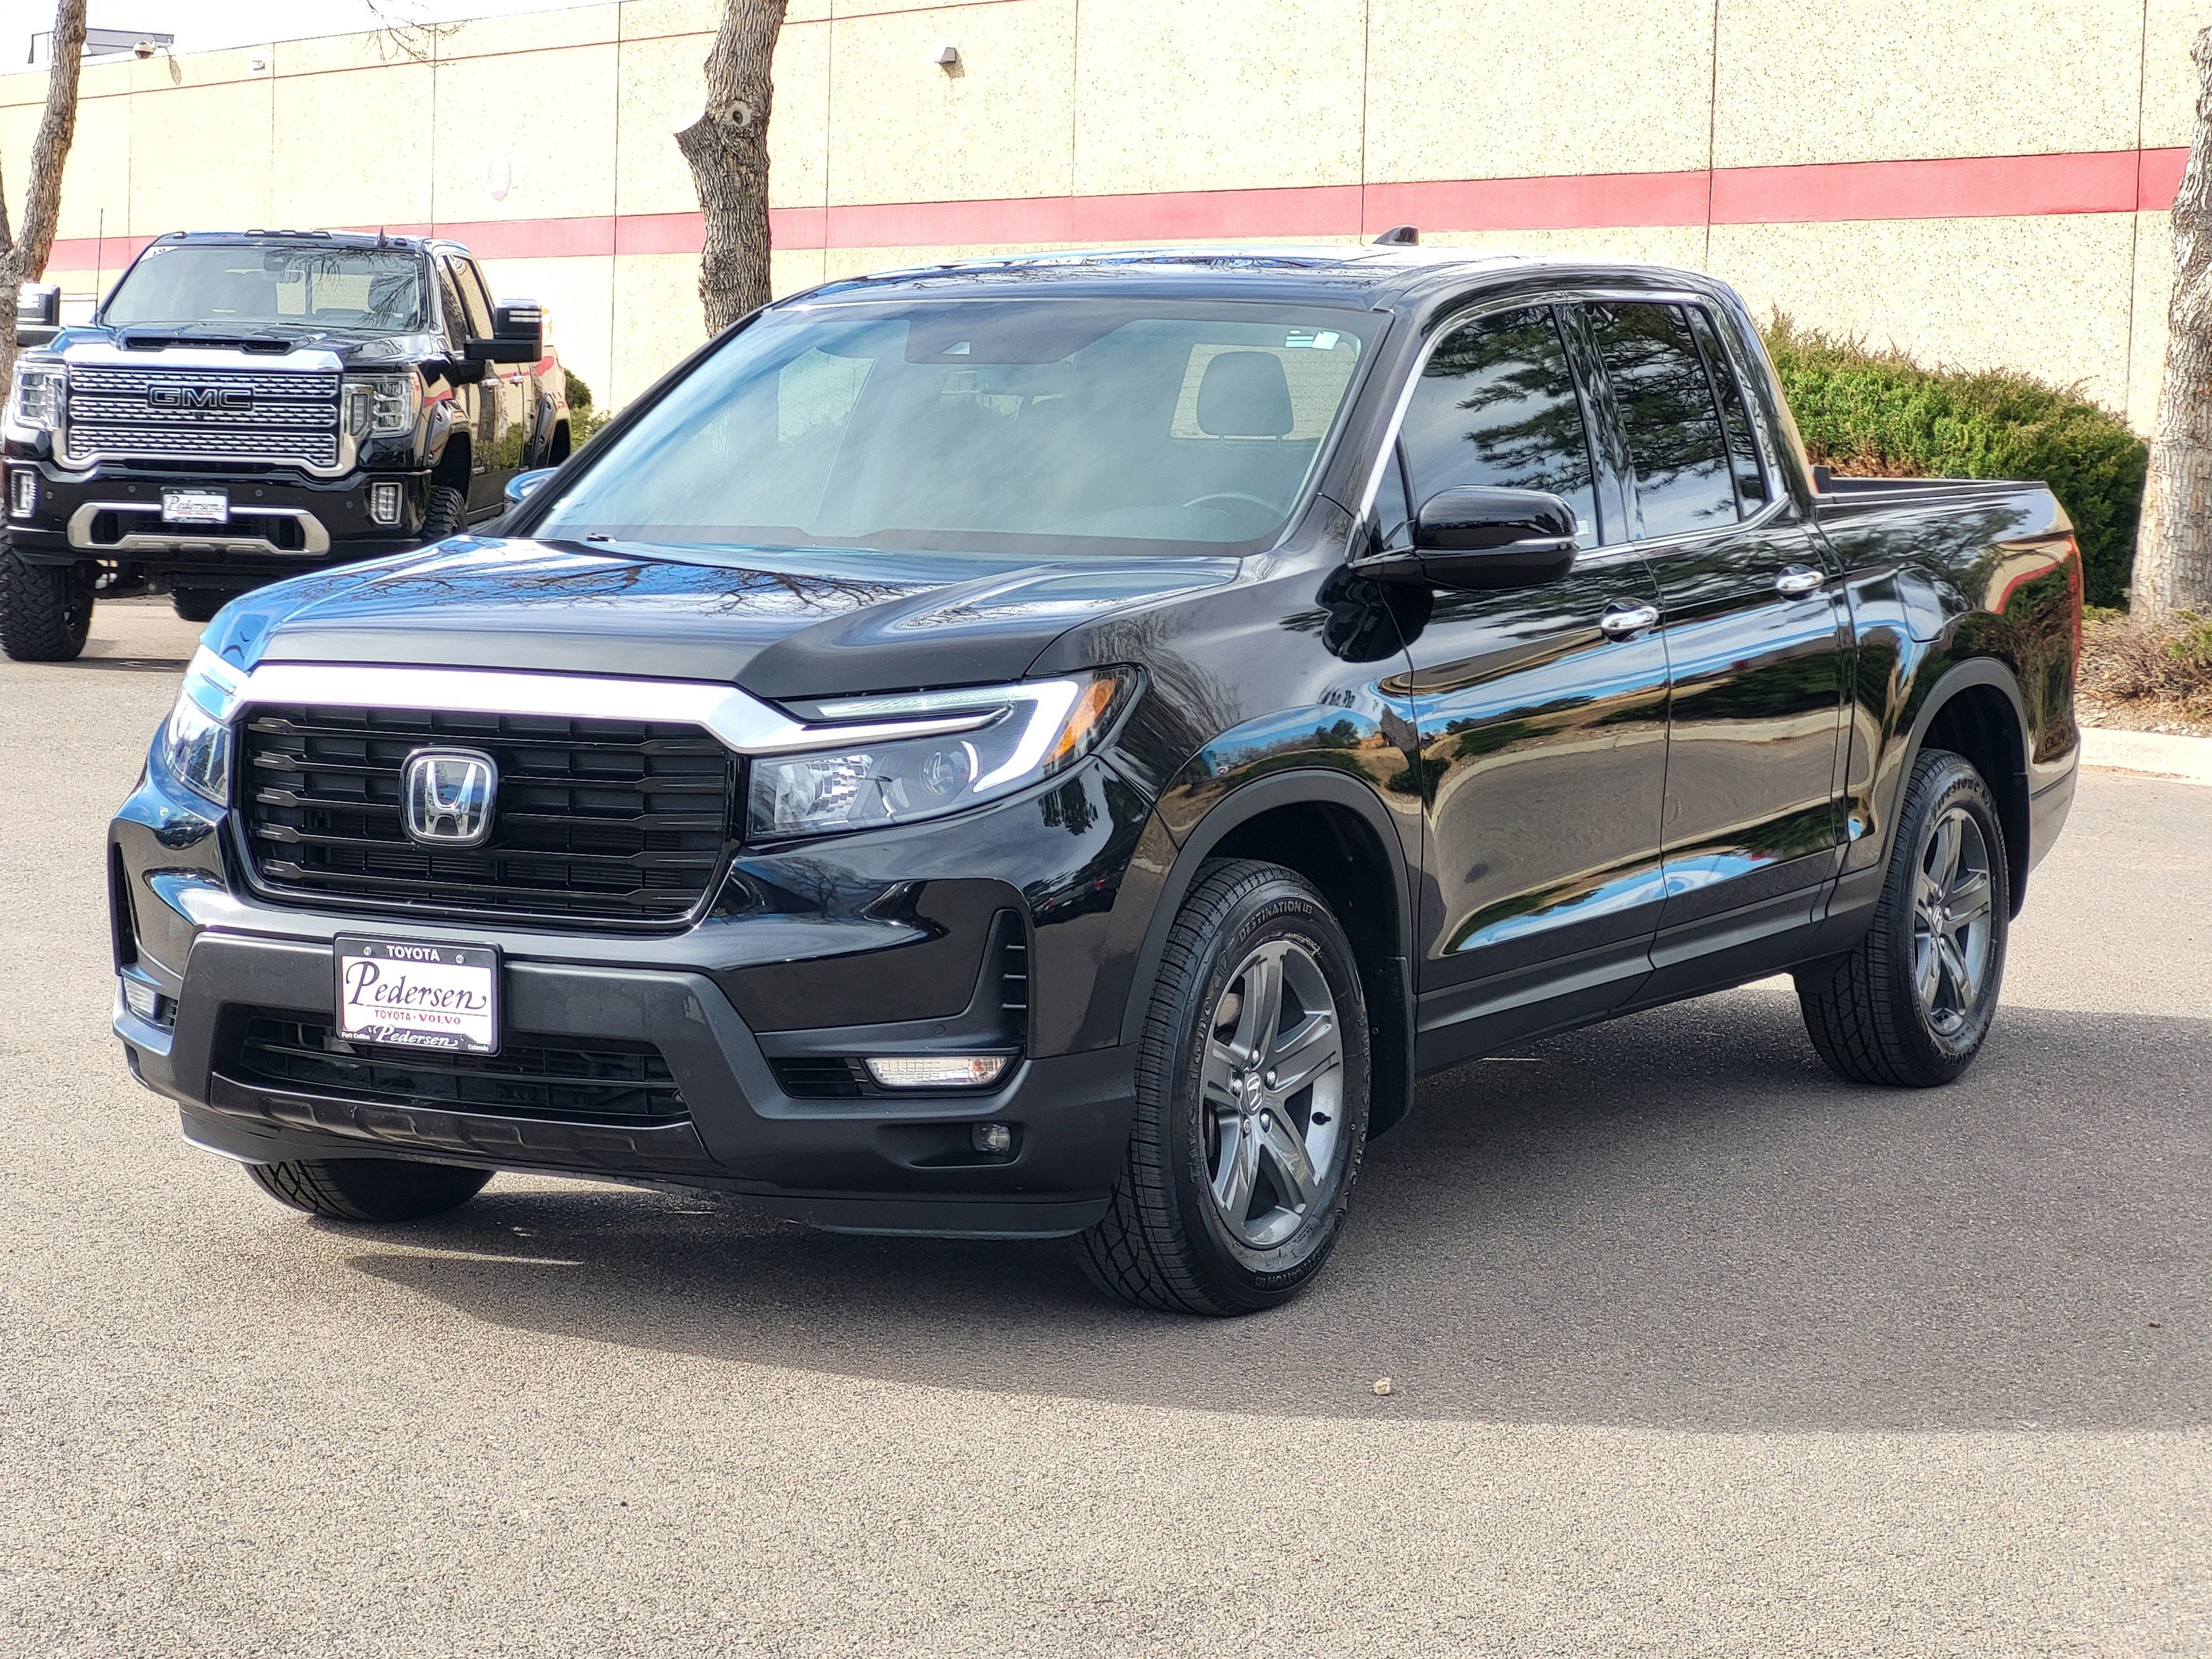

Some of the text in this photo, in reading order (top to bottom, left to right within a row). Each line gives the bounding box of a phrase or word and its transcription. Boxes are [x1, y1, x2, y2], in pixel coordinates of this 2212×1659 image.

[150, 388, 252, 409] GMC
[1239, 901, 1313, 942] DESTINATION LE3
[387, 946, 440, 962] TOYOTA
[347, 962, 487, 1009] Pedersen
[375, 1010, 461, 1024] TOYOTA VOLVO
[373, 1025, 459, 1047] Pedersen
